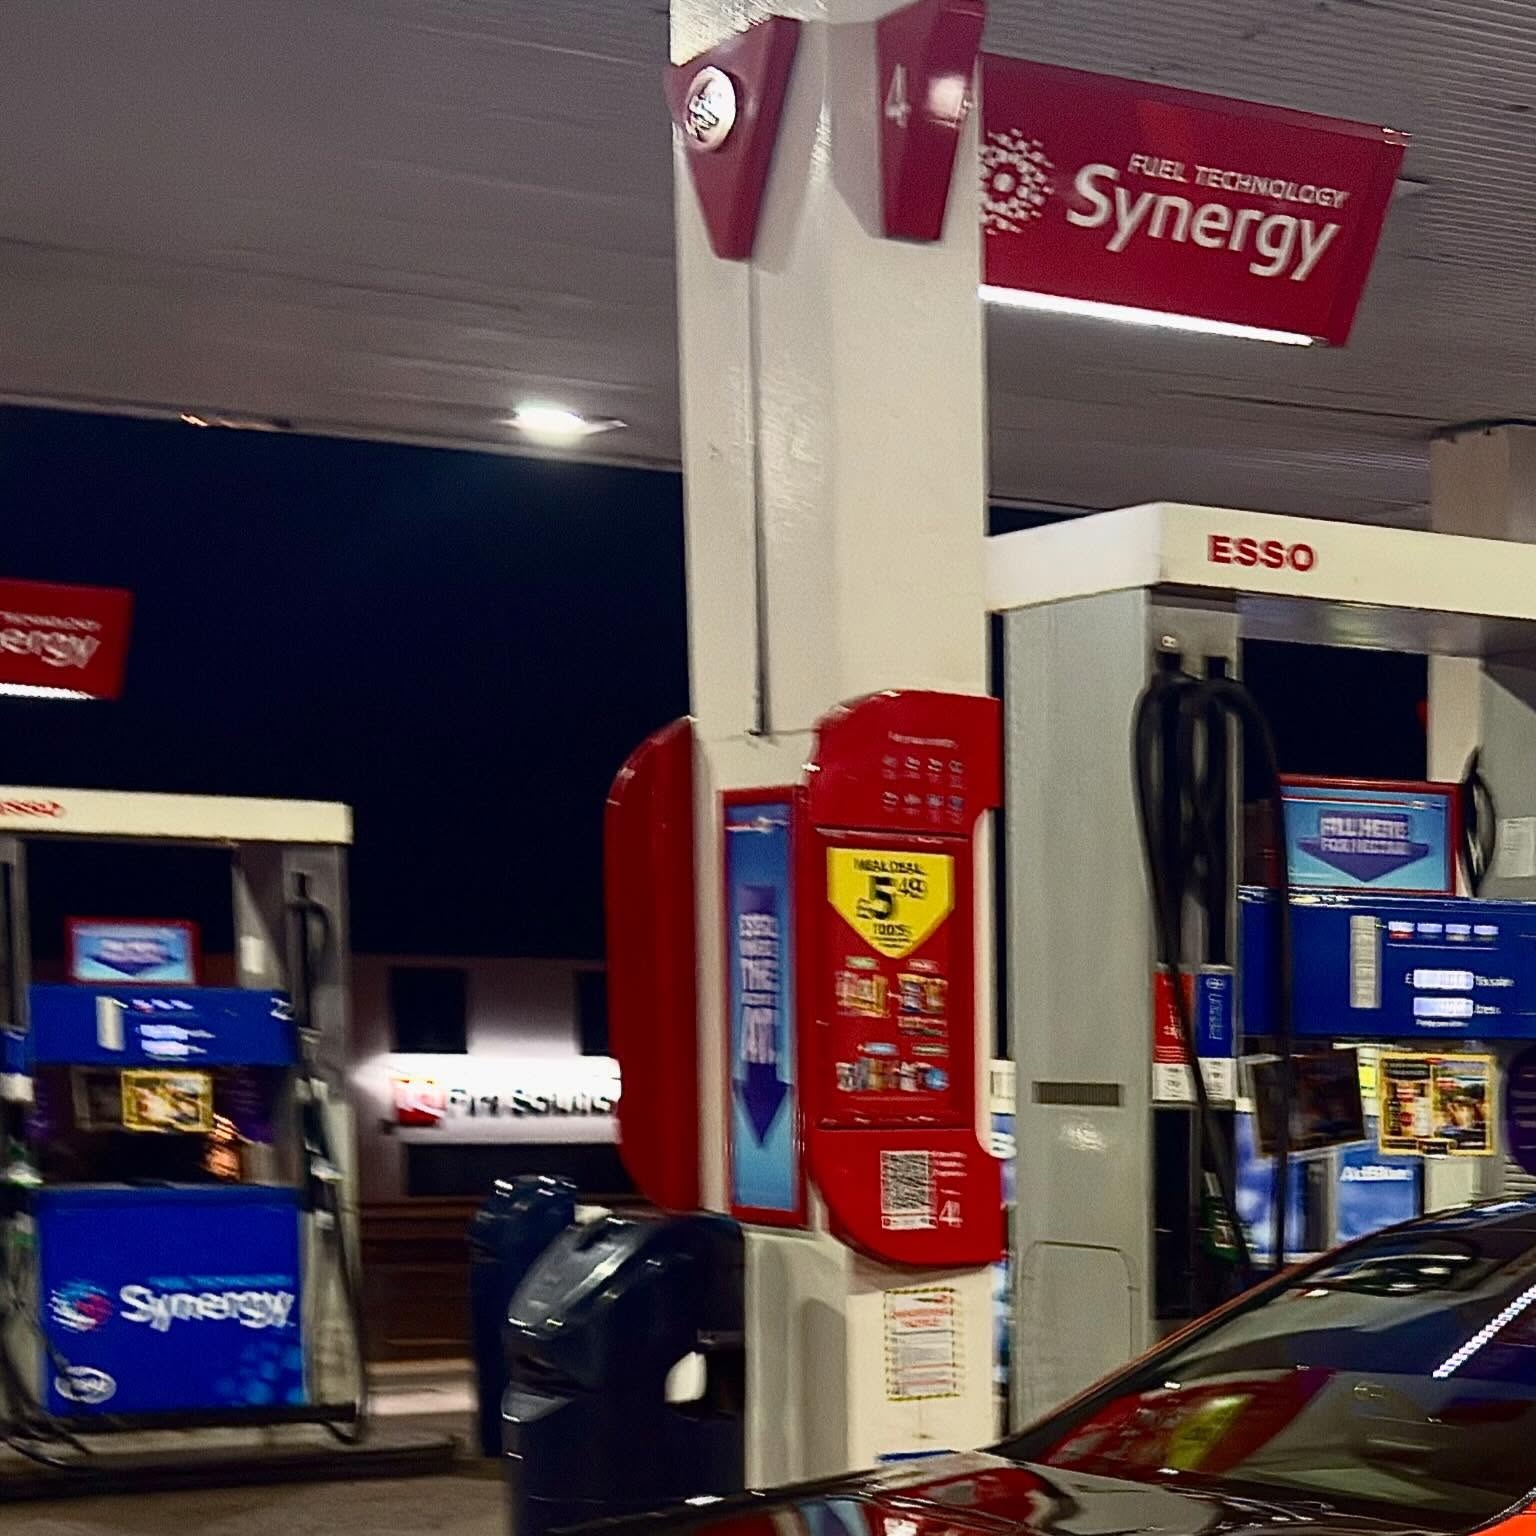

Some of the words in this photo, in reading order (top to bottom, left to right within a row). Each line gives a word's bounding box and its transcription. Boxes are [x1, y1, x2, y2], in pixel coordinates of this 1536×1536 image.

[885, 63, 911, 128] 4
[1127, 152, 1189, 184] FUEL
[1194, 164, 1351, 209] TECHNOLOGY
[1066, 162, 1342, 282] Synergy
[1207, 534, 1318, 572] ESSO
[0, 628, 102, 669] ergy
[938, 1200, 964, 1228] 4
[119, 1284, 296, 1333] Synergy
